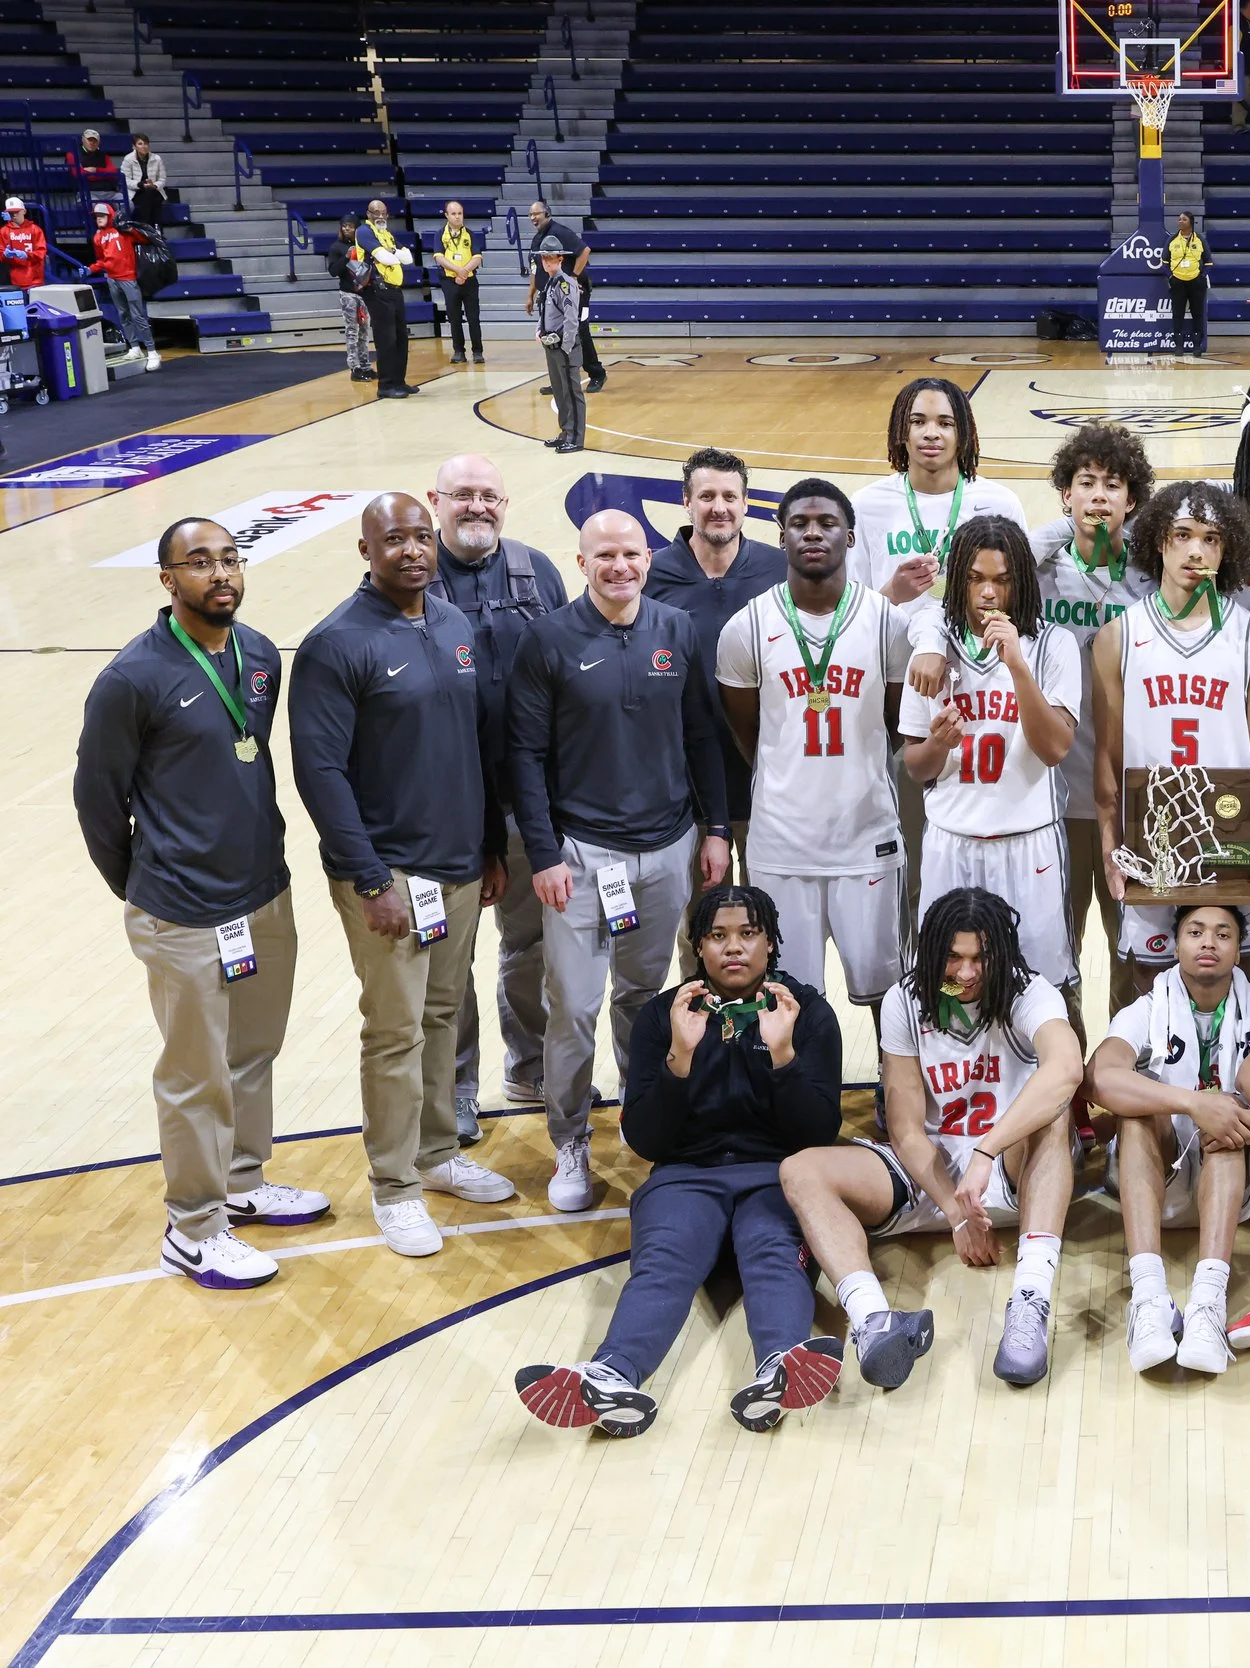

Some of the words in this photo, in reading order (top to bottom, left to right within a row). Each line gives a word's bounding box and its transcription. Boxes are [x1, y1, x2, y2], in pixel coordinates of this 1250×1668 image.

[1122, 235, 1164, 270] Krog
[1105, 296, 1147, 313] dave
[1112, 329, 1129, 339] The
[1130, 329, 1153, 340] place
[1105, 339, 1140, 349] Alexis
[1143, 340, 1158, 349] and
[1044, 598, 1101, 628] LOCK
[1142, 672, 1230, 712] IRISH
[803, 706, 845, 757] 11
[1170, 716, 1200, 767] 5
[959, 732, 1007, 785] 10
[602, 879, 626, 892] SINGLE
[605, 886, 626, 898] GAME
[415, 887, 439, 902] SINGLE
[418, 895, 438, 908] GAME
[219, 920, 246, 935] SINGLE
[223, 928, 245, 942] GAME
[926, 1055, 1001, 1095] IRISH
[938, 1090, 1000, 1137] 22
